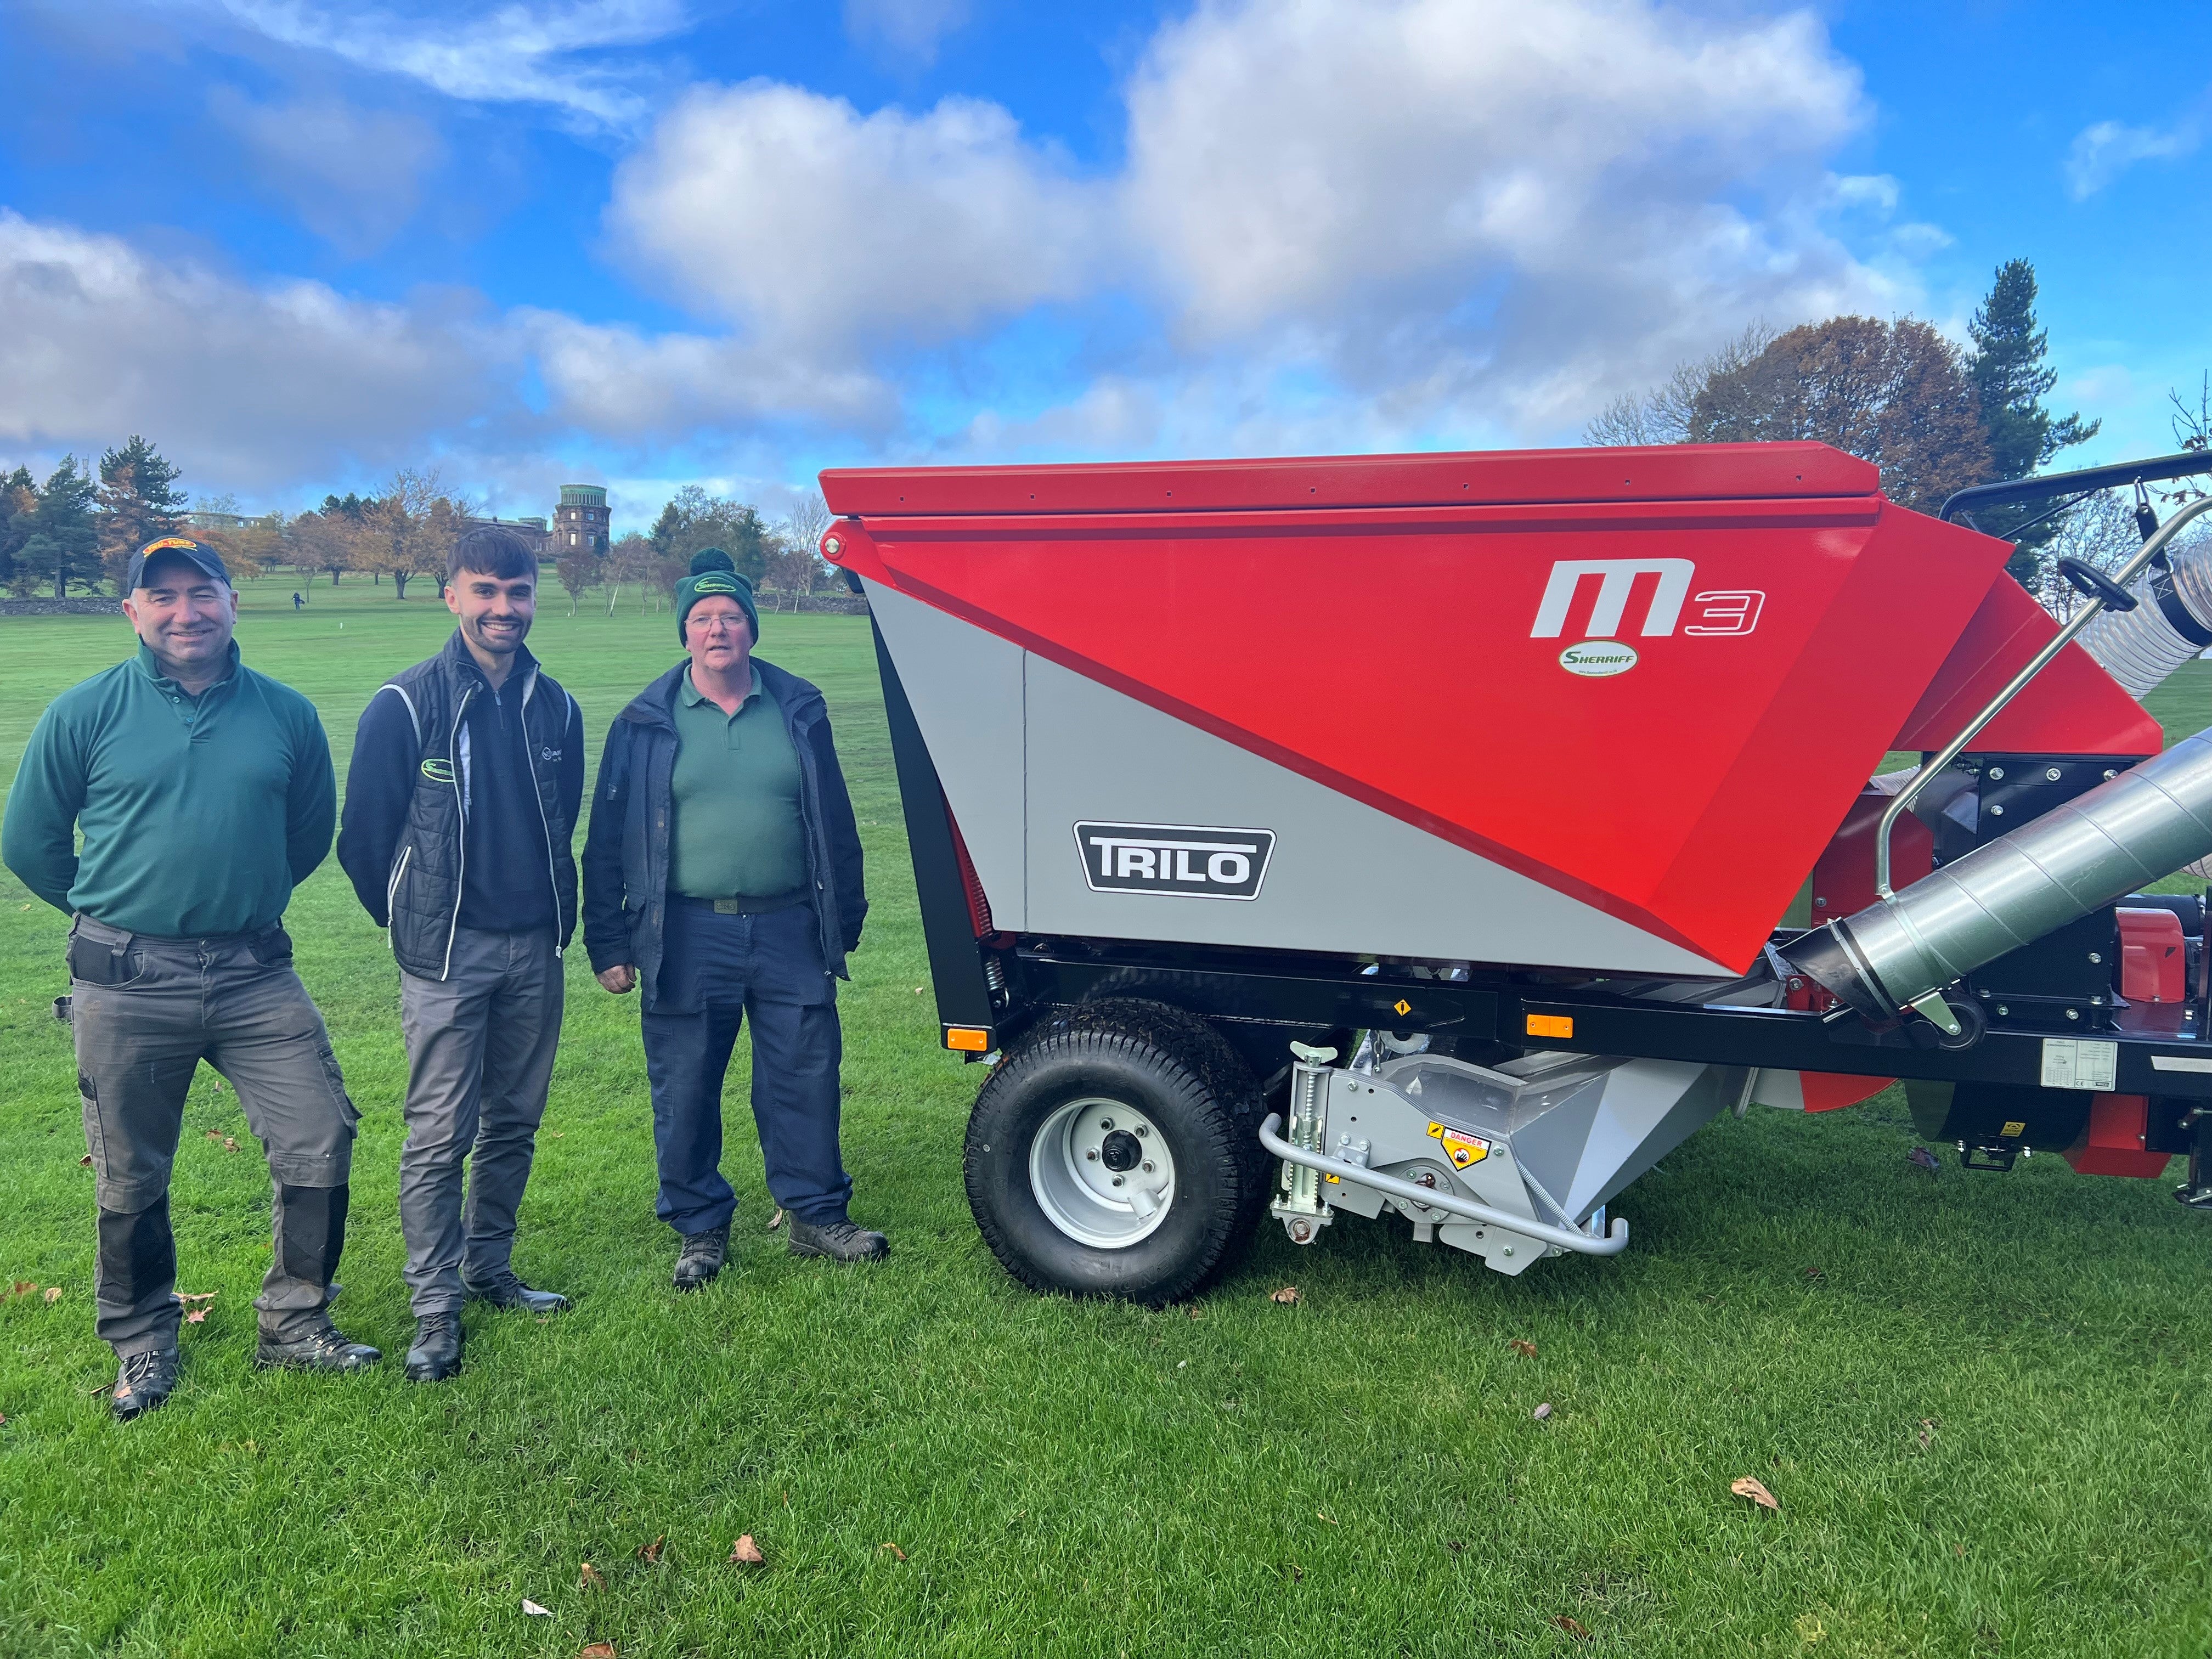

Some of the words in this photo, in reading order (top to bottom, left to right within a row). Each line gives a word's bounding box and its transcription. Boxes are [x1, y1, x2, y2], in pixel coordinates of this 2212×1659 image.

[1564, 651, 1634, 663] SHERRIFF
[1090, 837, 1257, 884] TRILO
[1451, 1132, 1482, 1147] DANGER
